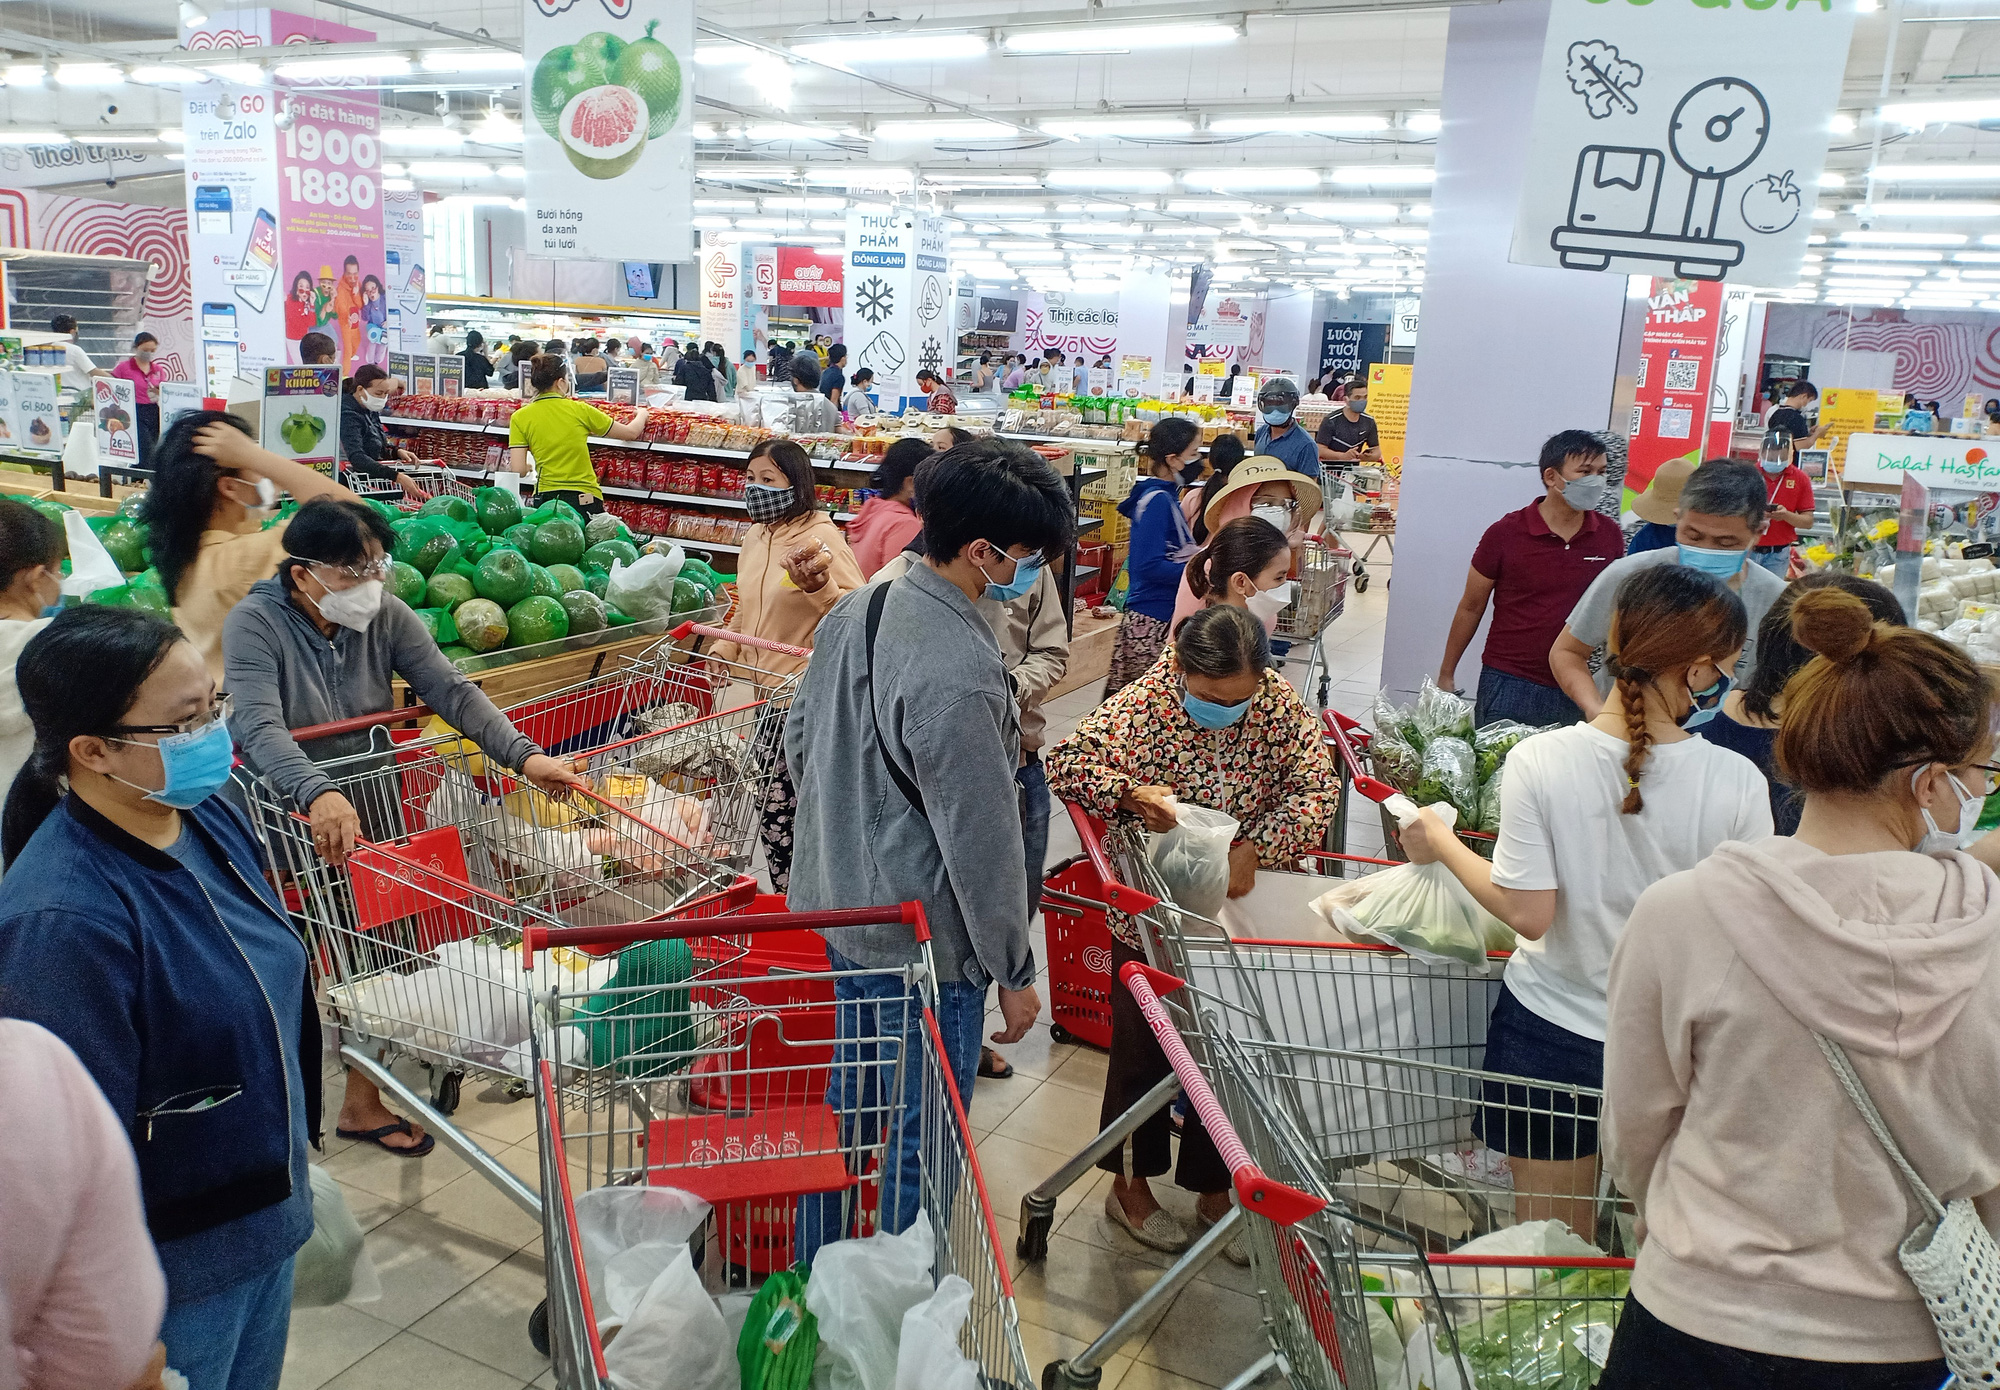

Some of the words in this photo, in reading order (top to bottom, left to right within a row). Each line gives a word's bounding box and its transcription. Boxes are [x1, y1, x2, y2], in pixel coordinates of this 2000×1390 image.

[240, 95, 264, 113] GO
[310, 104, 334, 122] đặt
[338, 106, 375, 129] hàng
[200, 130, 219, 140] trên
[224, 121, 256, 140] Zalo
[282, 123, 376, 168] 1900
[284, 166, 376, 210] 1880
[406, 210, 420, 219] GO
[537, 209, 557, 220] Bưởi
[560, 209, 583, 221] hồng
[396, 220, 416, 231] Zalo
[542, 225, 553, 234] da
[556, 225, 577, 234] xanh
[544, 239, 556, 248] túi
[559, 239, 576, 249] lưới
[860, 229, 898, 247] PHẨM
[854, 254, 879, 264] ĐÔNG
[880, 256, 904, 266] LẠNH
[780, 280, 812, 292] THANH
[813, 279, 841, 292] TOÁN
[722, 291, 733, 299] lên
[1648, 288, 1689, 310] VẪN
[1049, 309, 1074, 324] Thịt
[1077, 310, 1099, 323] các
[1653, 304, 1706, 323] THẤP
[1327, 327, 1363, 341] LUÔN
[1328, 342, 1358, 356] TƯƠI
[1322, 358, 1362, 370] NGON
[22, 401, 53, 412] 61.800
[112, 438, 122, 448] 26
[1877, 452, 1933, 470] Dalat
[1245, 466, 1278, 475] Dior
